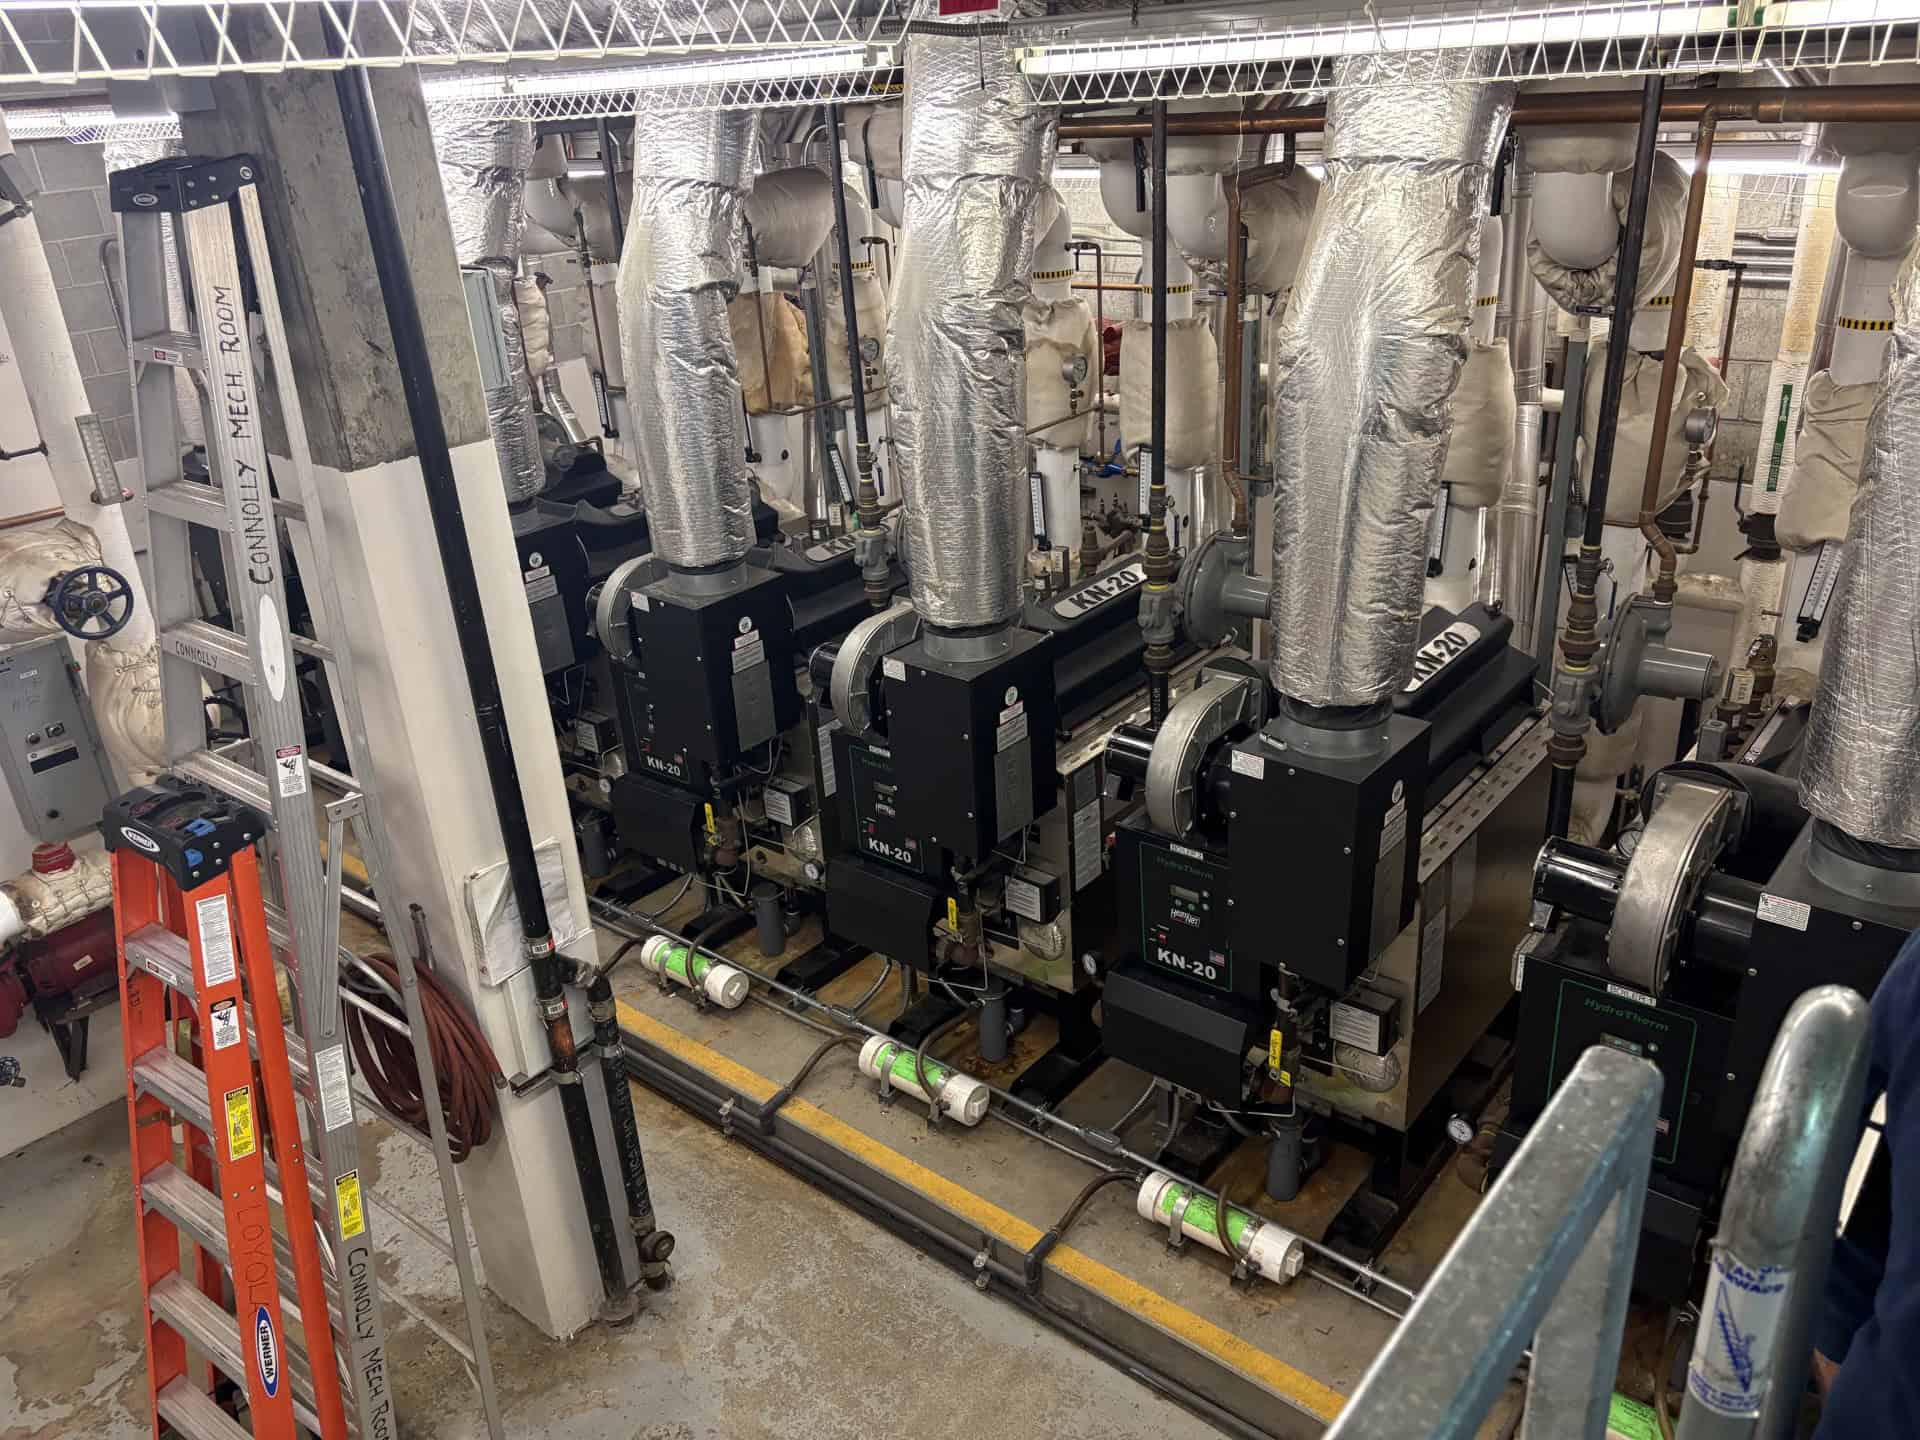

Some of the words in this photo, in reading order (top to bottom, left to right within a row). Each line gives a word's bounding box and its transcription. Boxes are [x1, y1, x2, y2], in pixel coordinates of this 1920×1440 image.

[213, 285, 241, 355] ROOM
[234, 459, 274, 585] CONNOLLY
[1068, 570, 1140, 609] KN-20
[174, 640, 218, 669] CONNOLLY
[647, 755, 681, 777] KN-20
[868, 837, 912, 864] KN-20
[1157, 946, 1217, 981] KN-20
[1584, 997, 1670, 1033] HydroTherm
[347, 1247, 376, 1341] CONNOLLY
[259, 1324, 275, 1379] WERNER
[361, 1347, 384, 1400] MECH
